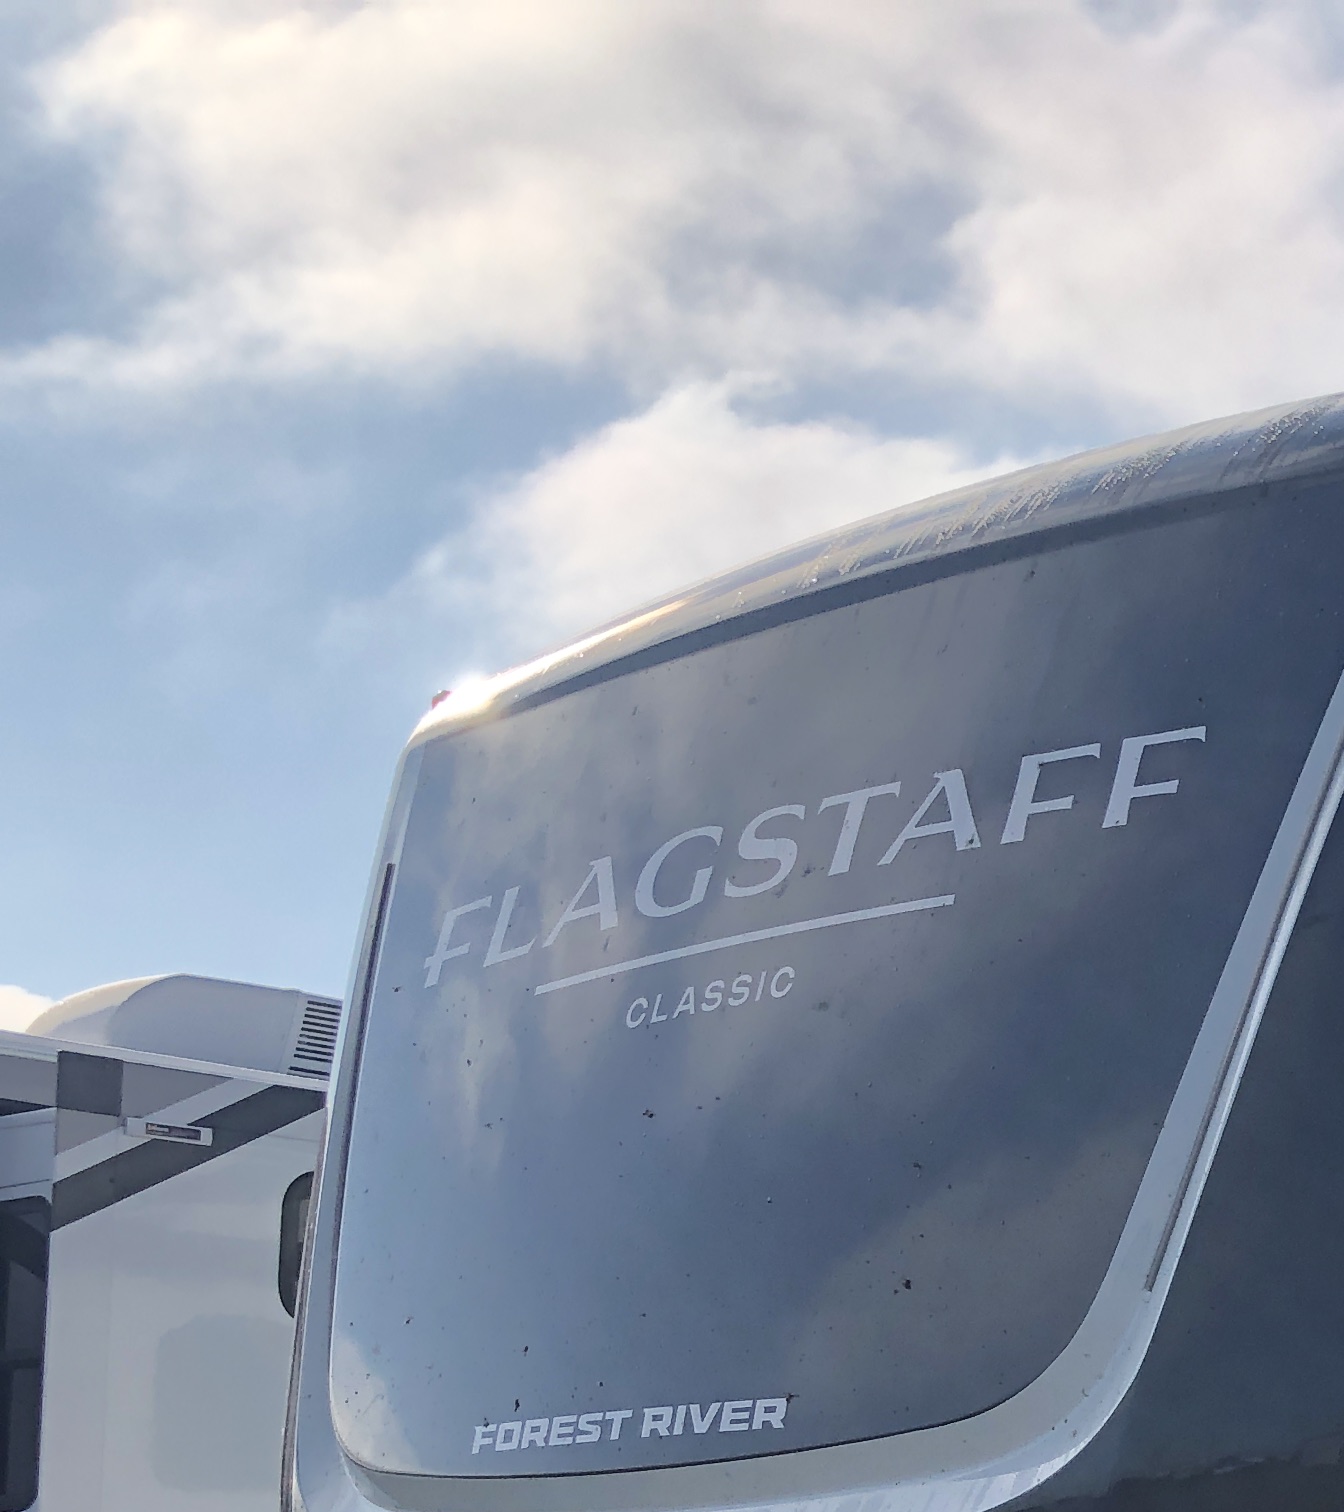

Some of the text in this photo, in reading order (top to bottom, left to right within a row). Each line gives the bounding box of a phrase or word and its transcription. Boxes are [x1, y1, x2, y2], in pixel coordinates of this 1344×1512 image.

[424, 725, 1207, 988] FLAGSTAFF
[625, 966, 796, 1030] CLASSIC
[471, 1396, 789, 1455] FOREST RIVER
